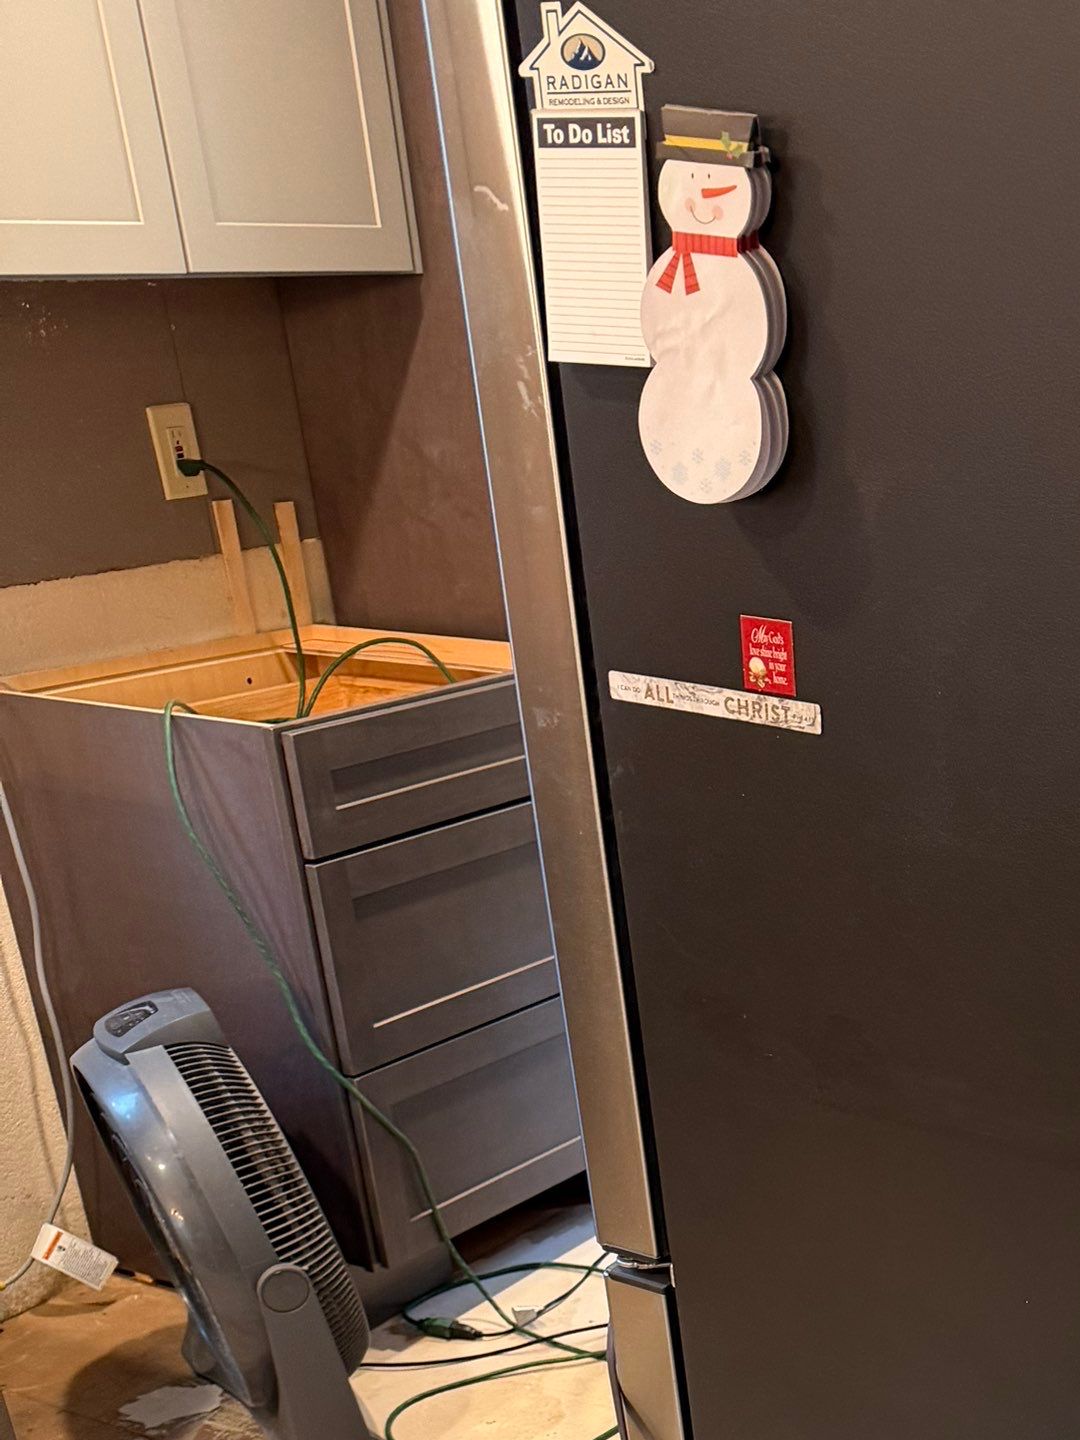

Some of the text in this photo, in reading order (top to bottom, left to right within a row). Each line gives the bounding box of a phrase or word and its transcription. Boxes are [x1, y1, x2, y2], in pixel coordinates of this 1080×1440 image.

[546, 73, 629, 90] RADIGAN
[549, 98, 595, 106] REMODELING
[603, 97, 630, 105] DESIGN
[543, 123, 630, 144] To Do List
[644, 682, 674, 704] ALL
[724, 696, 791, 723] CHRIST
